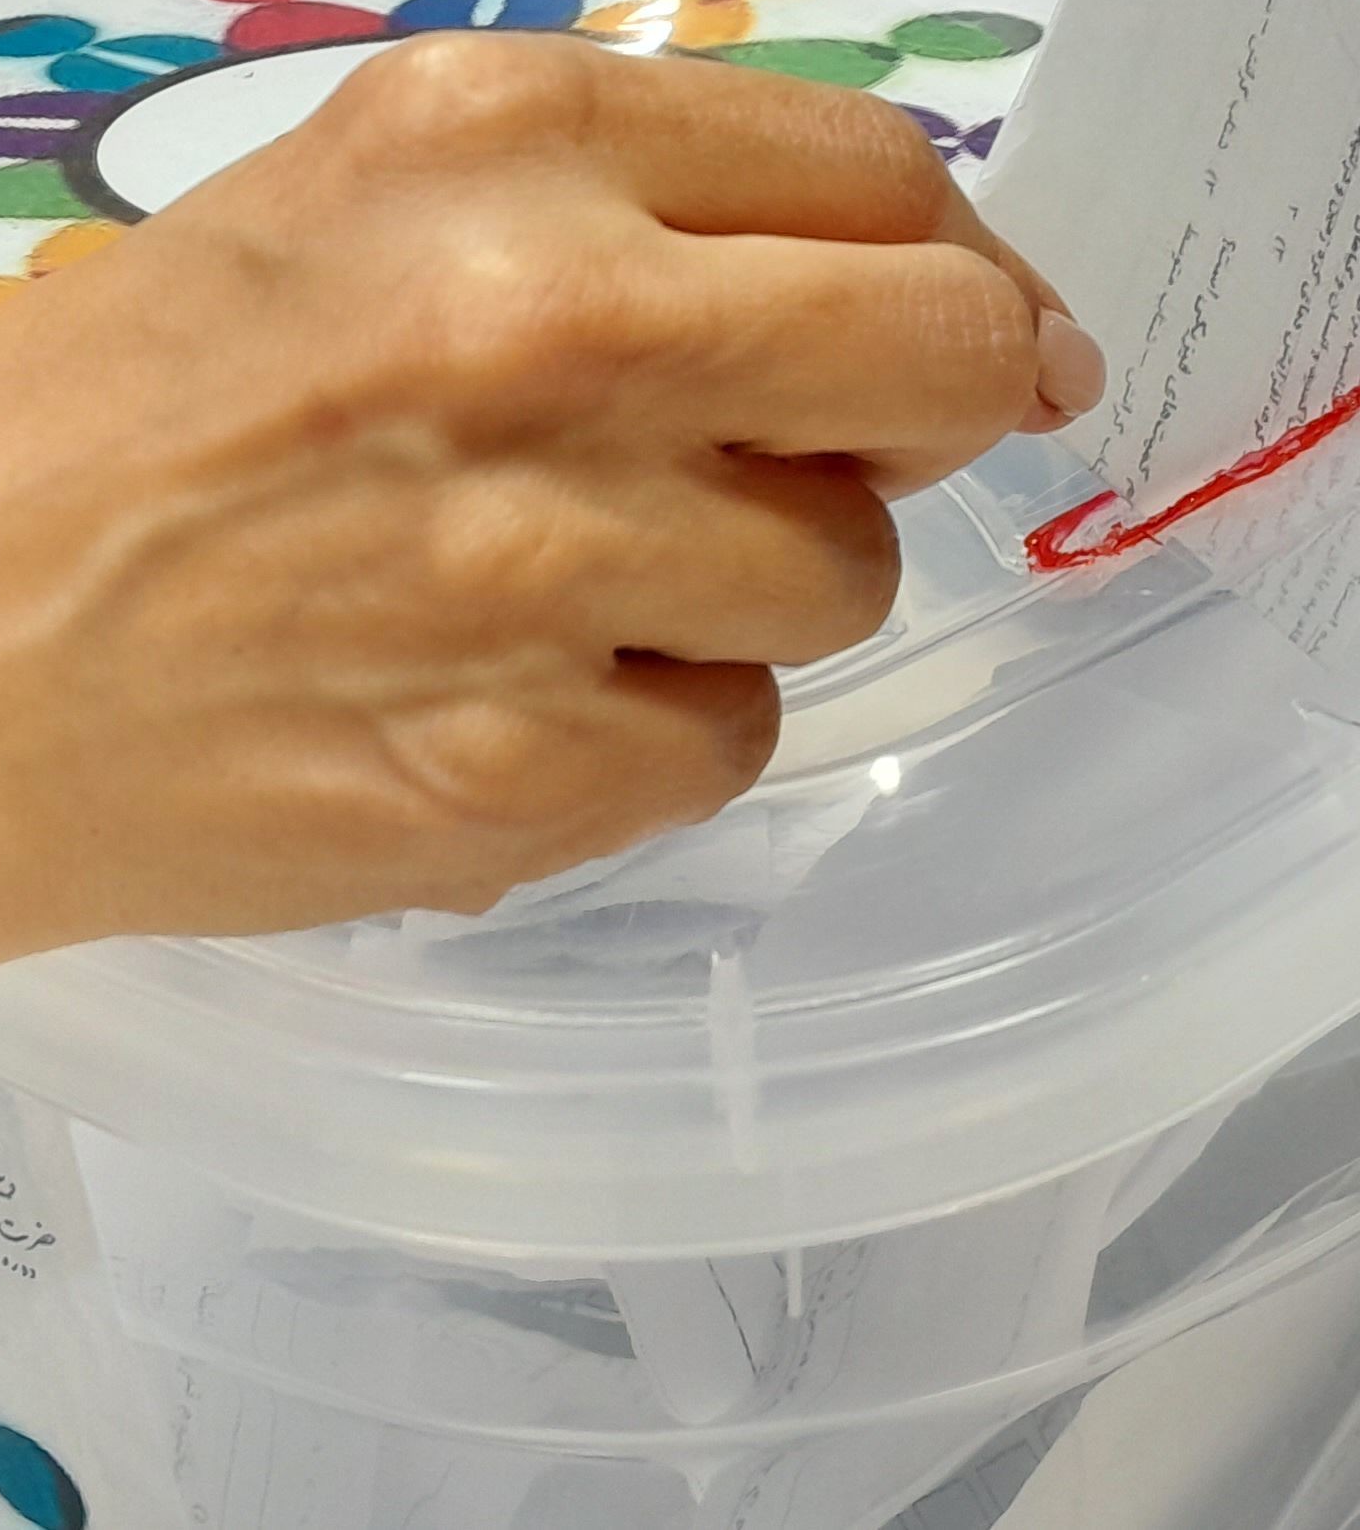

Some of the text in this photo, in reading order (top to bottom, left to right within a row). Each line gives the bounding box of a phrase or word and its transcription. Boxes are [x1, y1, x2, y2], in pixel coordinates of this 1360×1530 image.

[1146, 291, 1167, 342] شتاب
[1167, 222, 1198, 285] متوسط
[1177, 293, 1207, 374] فیزیکی
[1208, 237, 1235, 299] است؟
